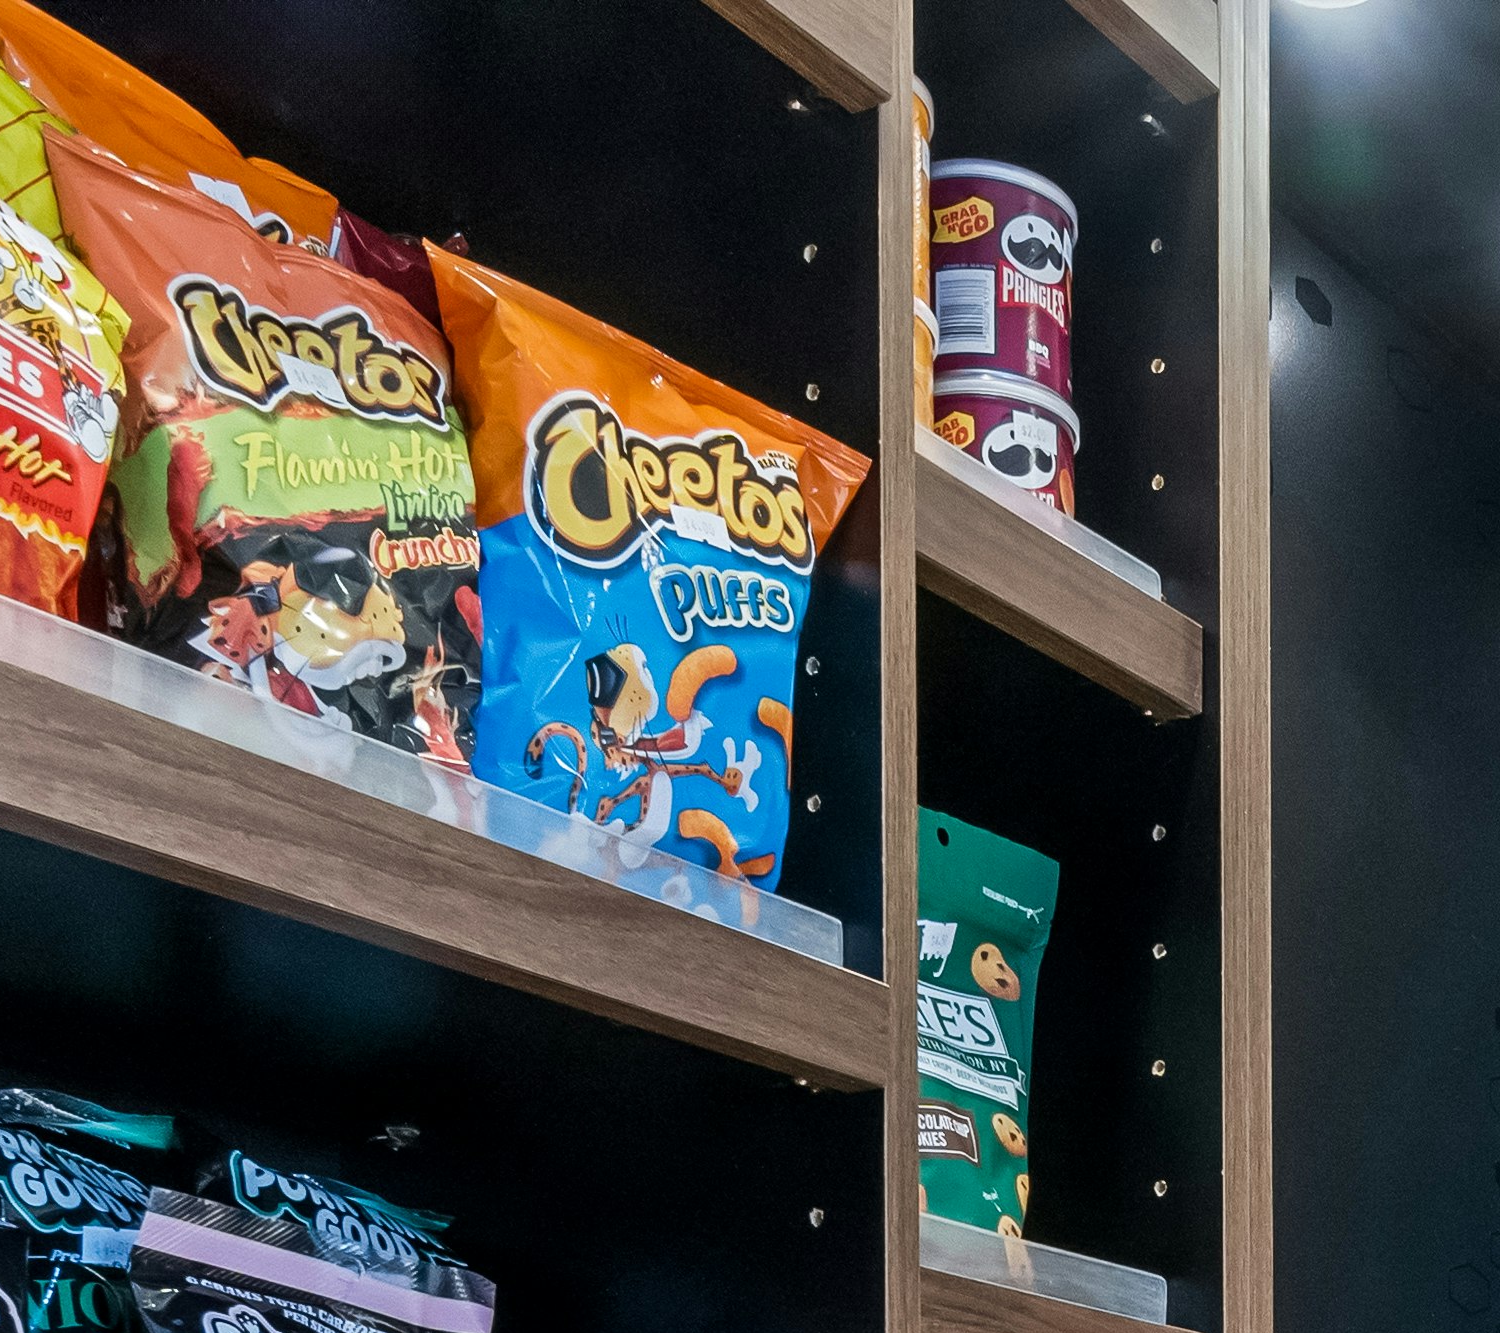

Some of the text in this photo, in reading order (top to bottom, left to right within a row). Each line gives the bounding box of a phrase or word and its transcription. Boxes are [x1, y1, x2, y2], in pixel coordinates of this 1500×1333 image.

[940, 204, 980, 226] GRAB
[959, 215, 989, 237] GO
[1002, 266, 1065, 328] PRINGLES
[185, 292, 445, 415] Cheetos
[234, 432, 466, 501] Flamin' Hot
[540, 403, 807, 560] Cheetos
[9, 481, 73, 521] Flavored
[369, 535, 481, 579] Crunchy
[990, 1059, 1010, 1075] NY
[202, 1280, 308, 1321] GRAMS TOTAL
[283, 1308, 316, 1330] PER
